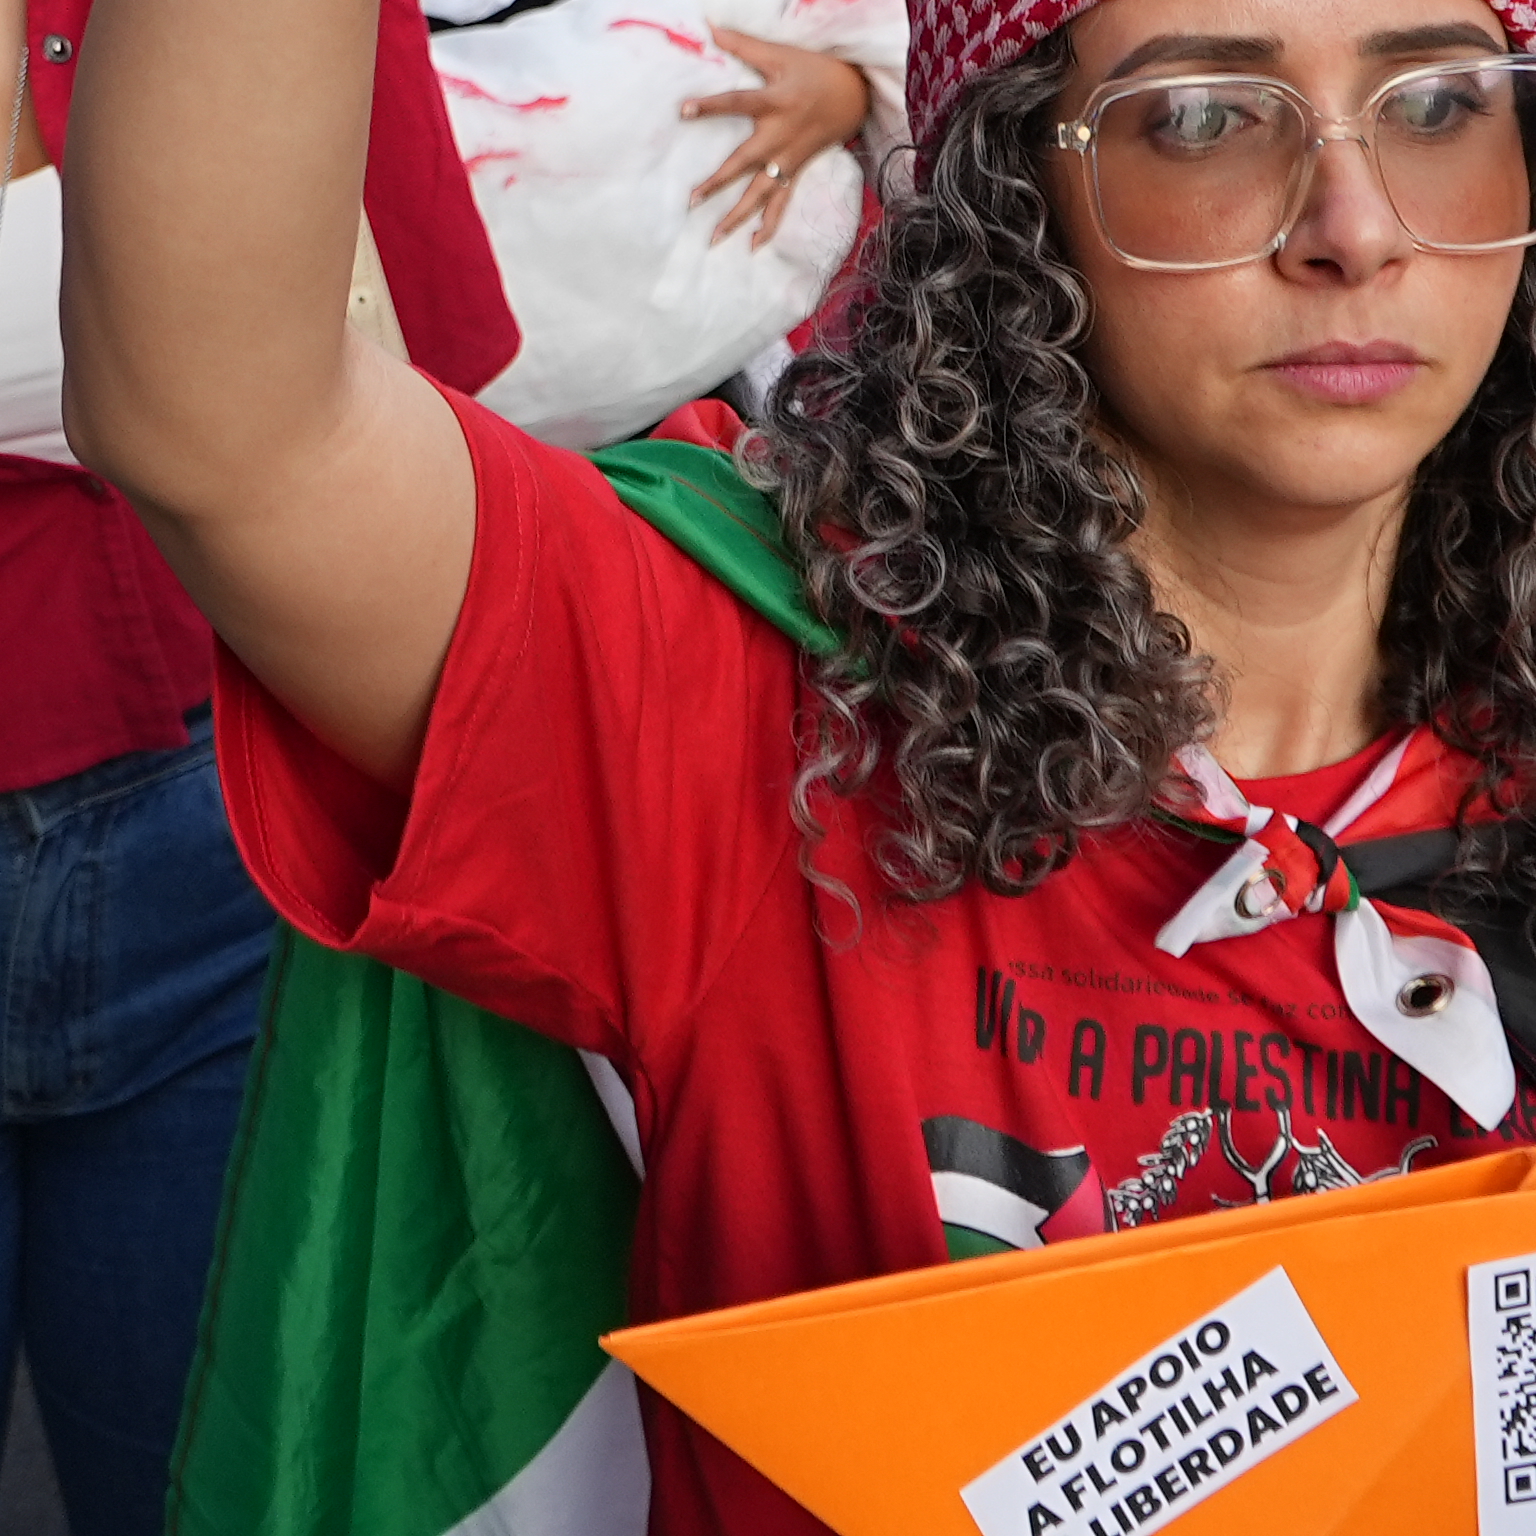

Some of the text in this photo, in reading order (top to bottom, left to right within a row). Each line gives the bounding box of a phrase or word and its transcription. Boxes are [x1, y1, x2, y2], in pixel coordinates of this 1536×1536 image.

[1069, 1017, 1107, 1101] A
[1131, 1022, 1421, 1128] PALESTINA
[1020, 1320, 1232, 1485] EU APOIO
[1025, 1348, 1280, 1536] A FLOTILHA
[1087, 1362, 1342, 1536] LIBERDADE
